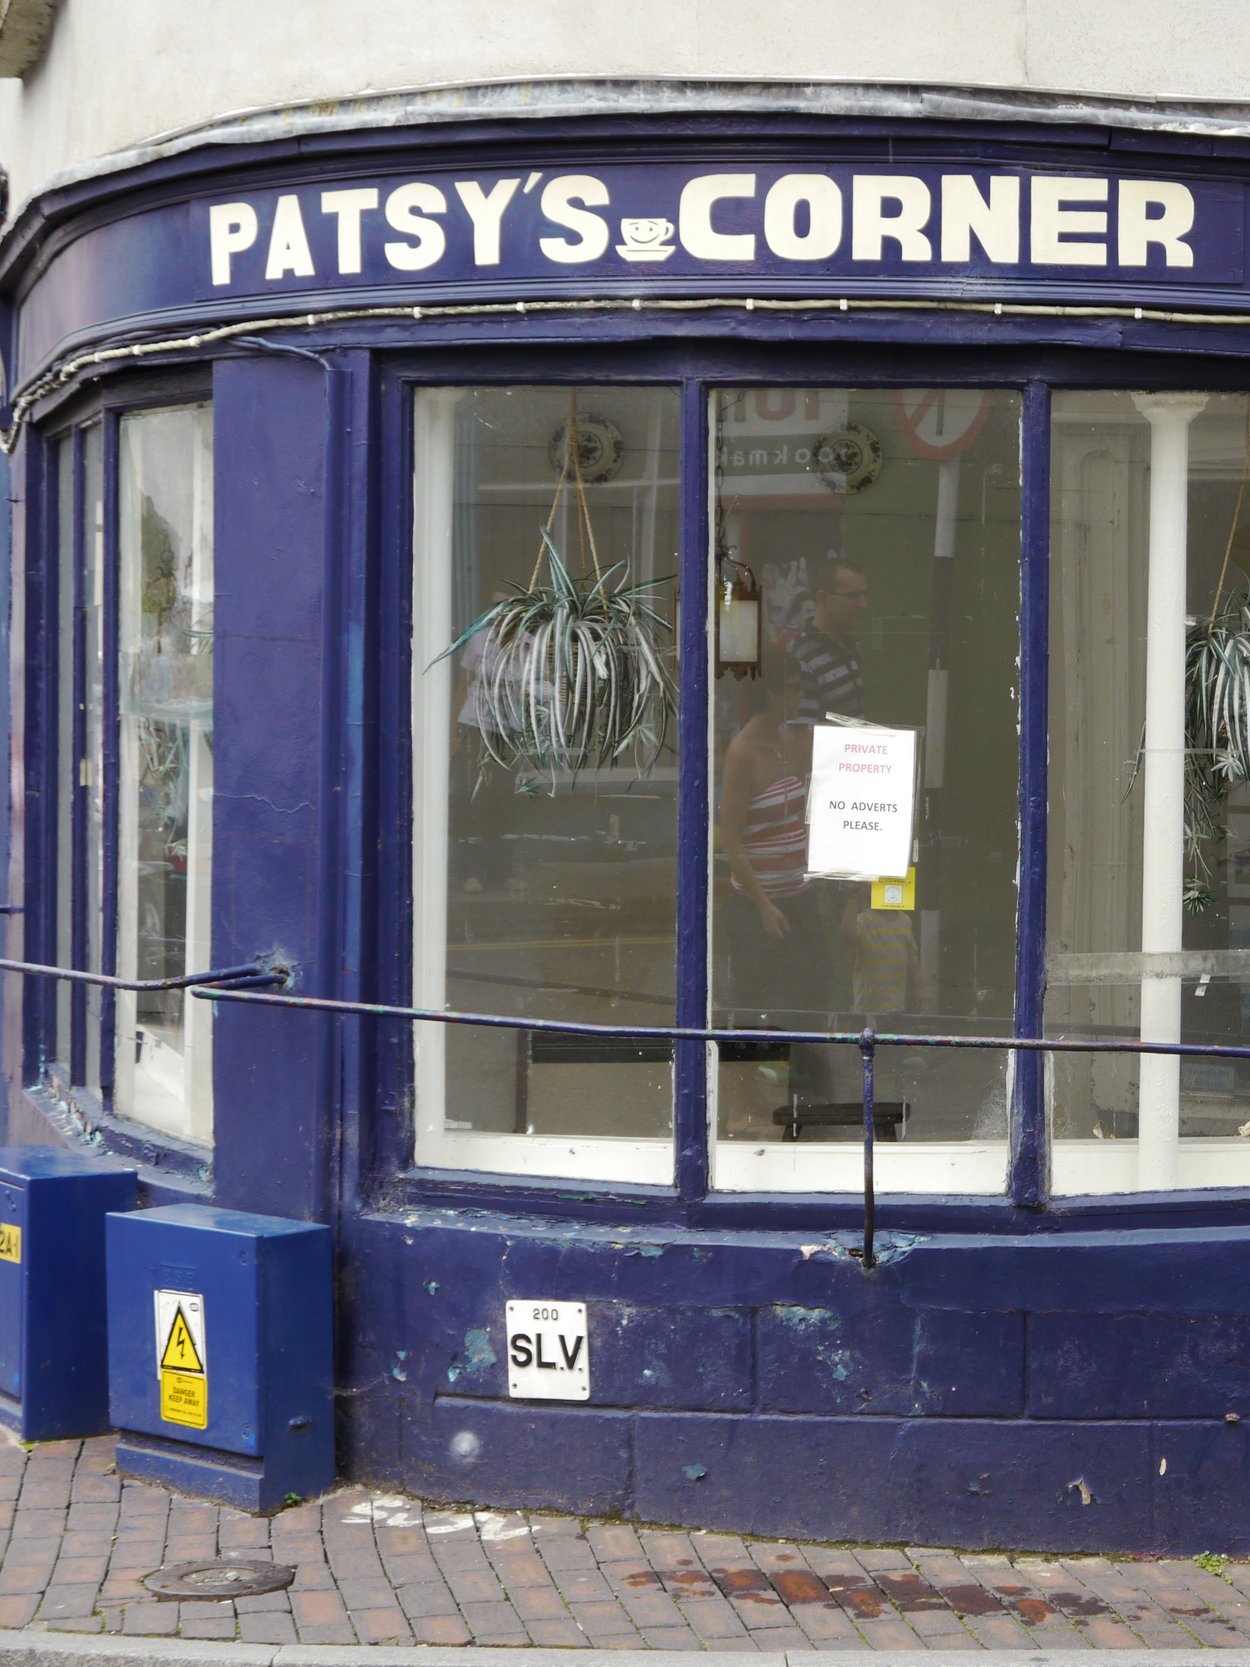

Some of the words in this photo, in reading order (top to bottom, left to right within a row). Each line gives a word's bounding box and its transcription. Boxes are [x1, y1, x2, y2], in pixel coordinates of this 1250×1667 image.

[209, 170, 612, 287] PATSY'S
[678, 172, 1196, 270] CORNER
[844, 743, 888, 755] PRIVATE
[838, 762, 892, 775] PROPERTY
[829, 800, 846, 811] NO
[850, 801, 898, 813] ADVERTS
[842, 820, 883, 832] PLEASE.
[532, 1308, 559, 1321] 200
[173, 1386, 195, 1398] DANGER
[168, 1394, 183, 1403] KEEP
[184, 1397, 200, 1407] AWAY
